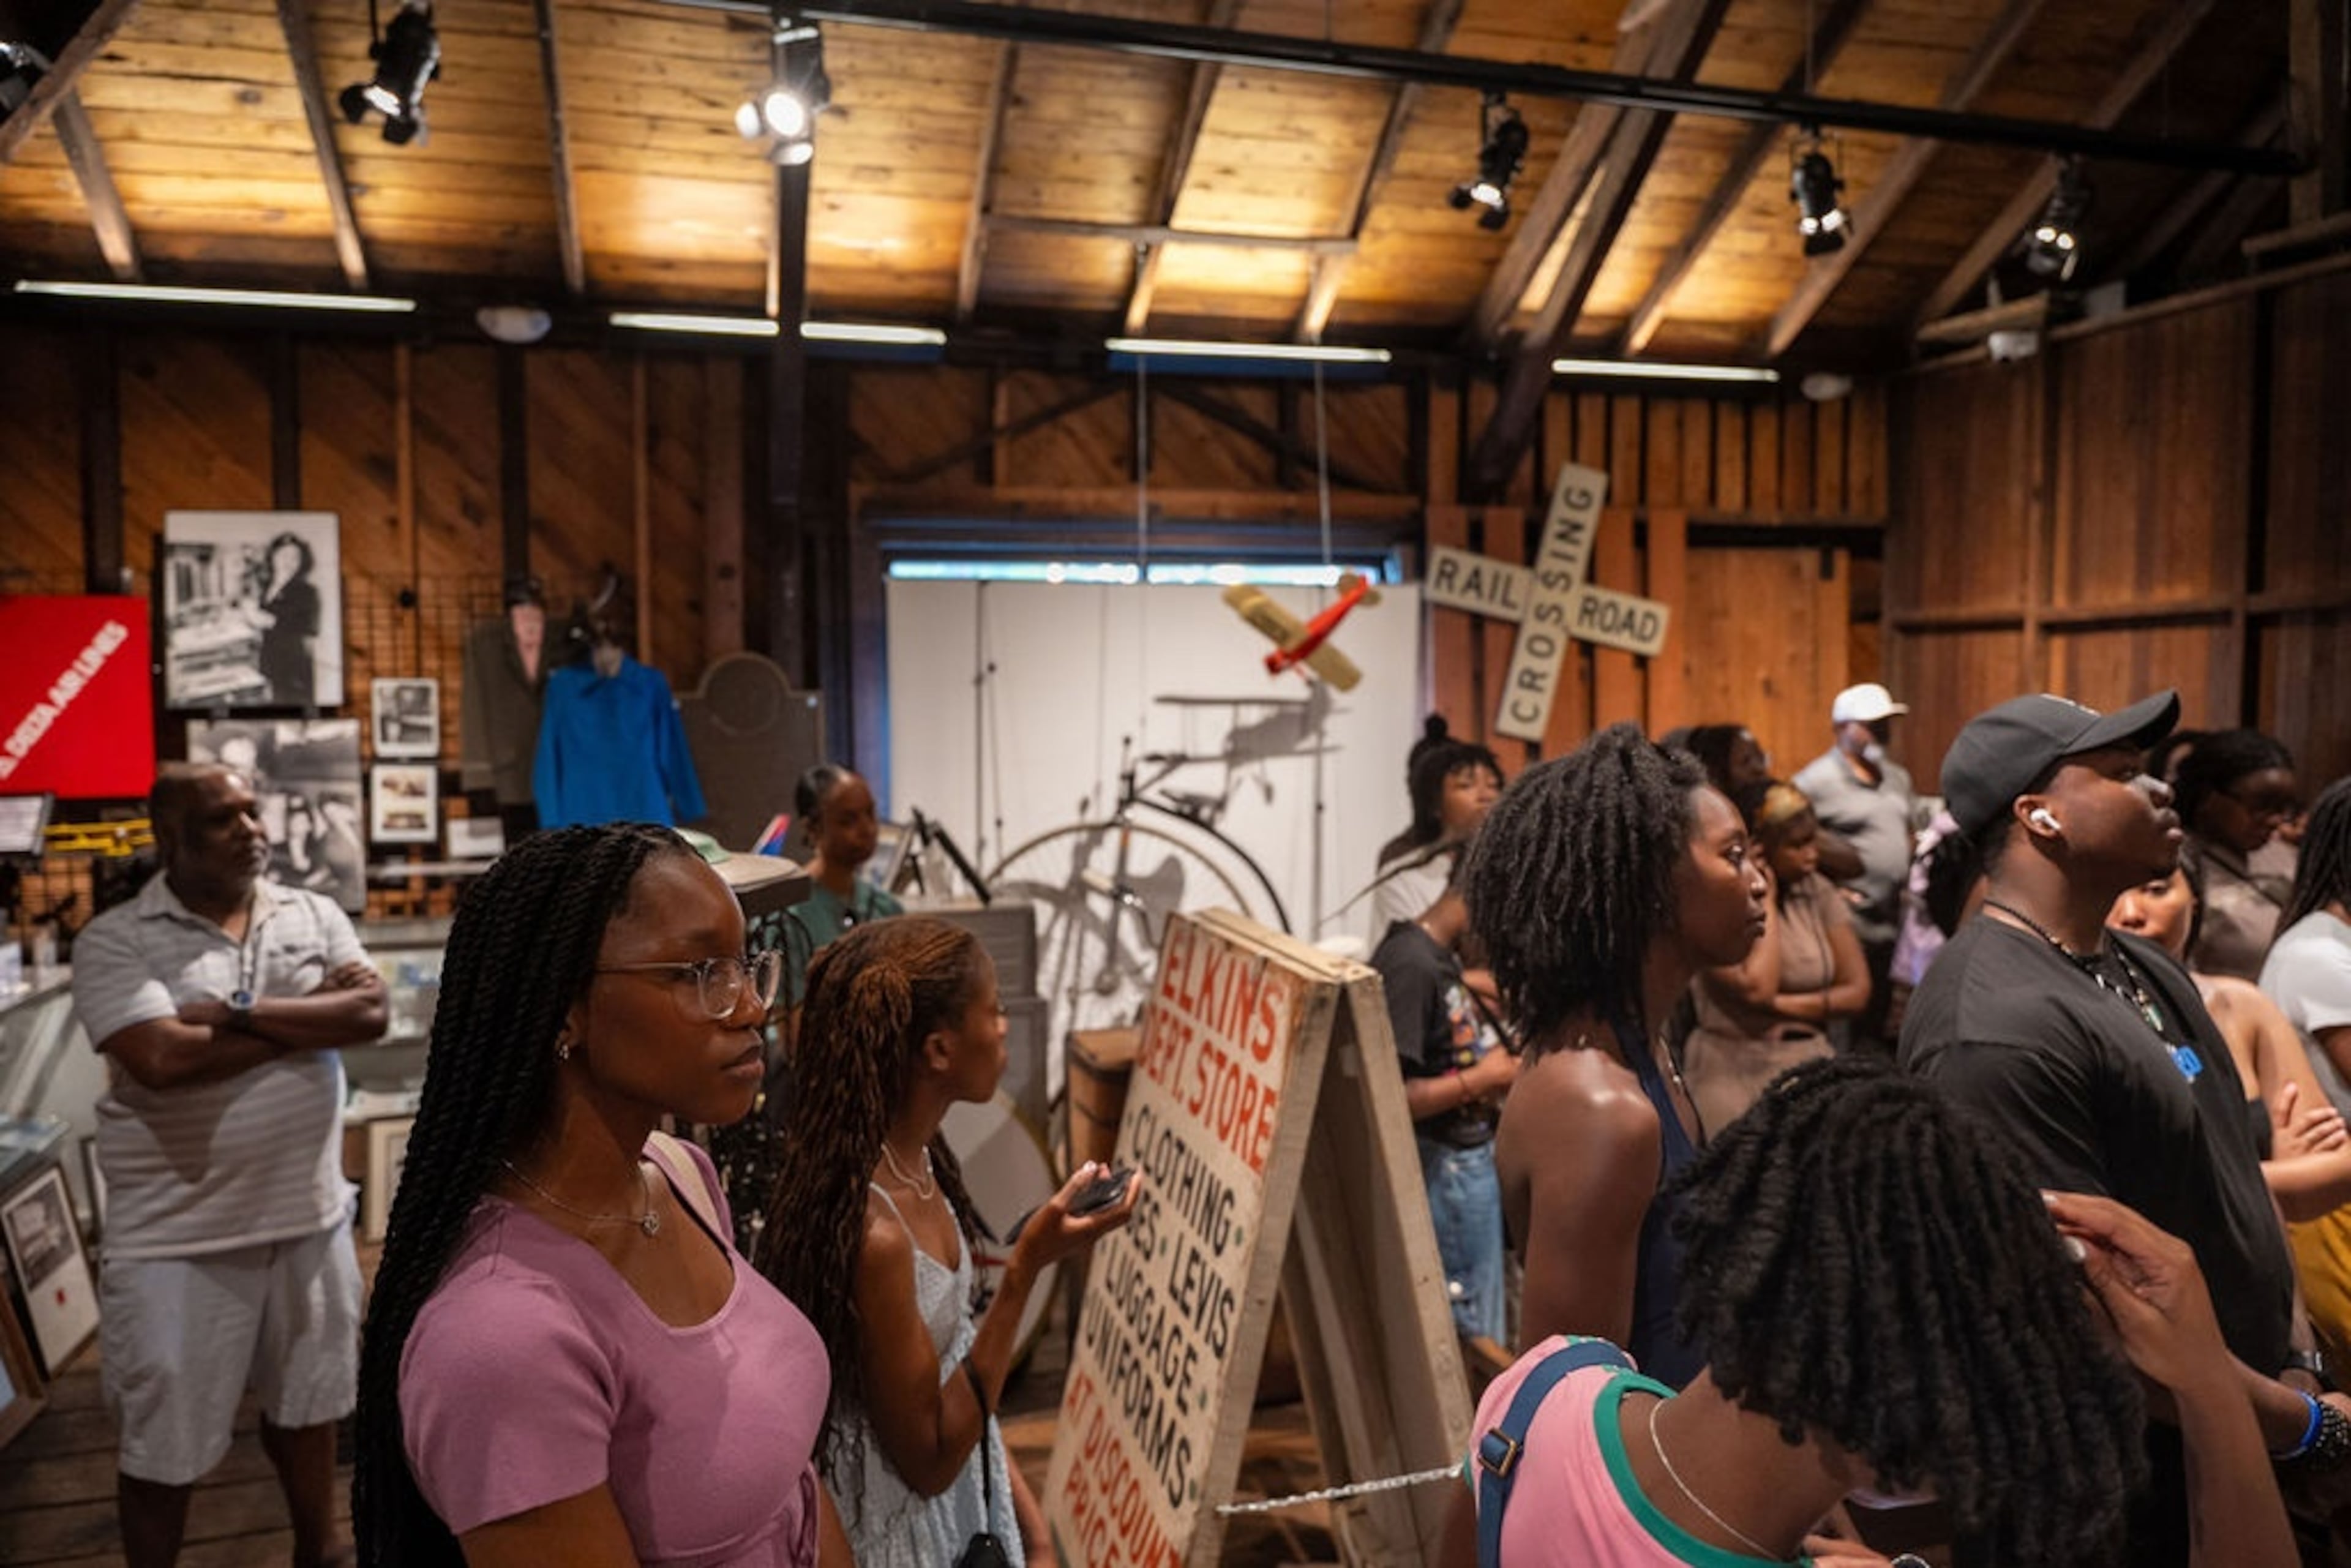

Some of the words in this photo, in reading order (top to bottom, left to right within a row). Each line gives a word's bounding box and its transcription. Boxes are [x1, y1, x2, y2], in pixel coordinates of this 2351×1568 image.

[1434, 558, 1518, 610] RAIL
[1577, 596, 1659, 643] ROAD
[1510, 487, 1592, 723] CROSSING
[1161, 928, 1284, 1063] ELKINS
[1134, 1103, 1235, 1257] CLOTHING
[1188, 1039, 1277, 1176] STORE
[1106, 1236, 1197, 1416] LUGGAGE
[1169, 1231, 1234, 1360] LEVIS
[1087, 1288, 1191, 1509] UNIFORMS
